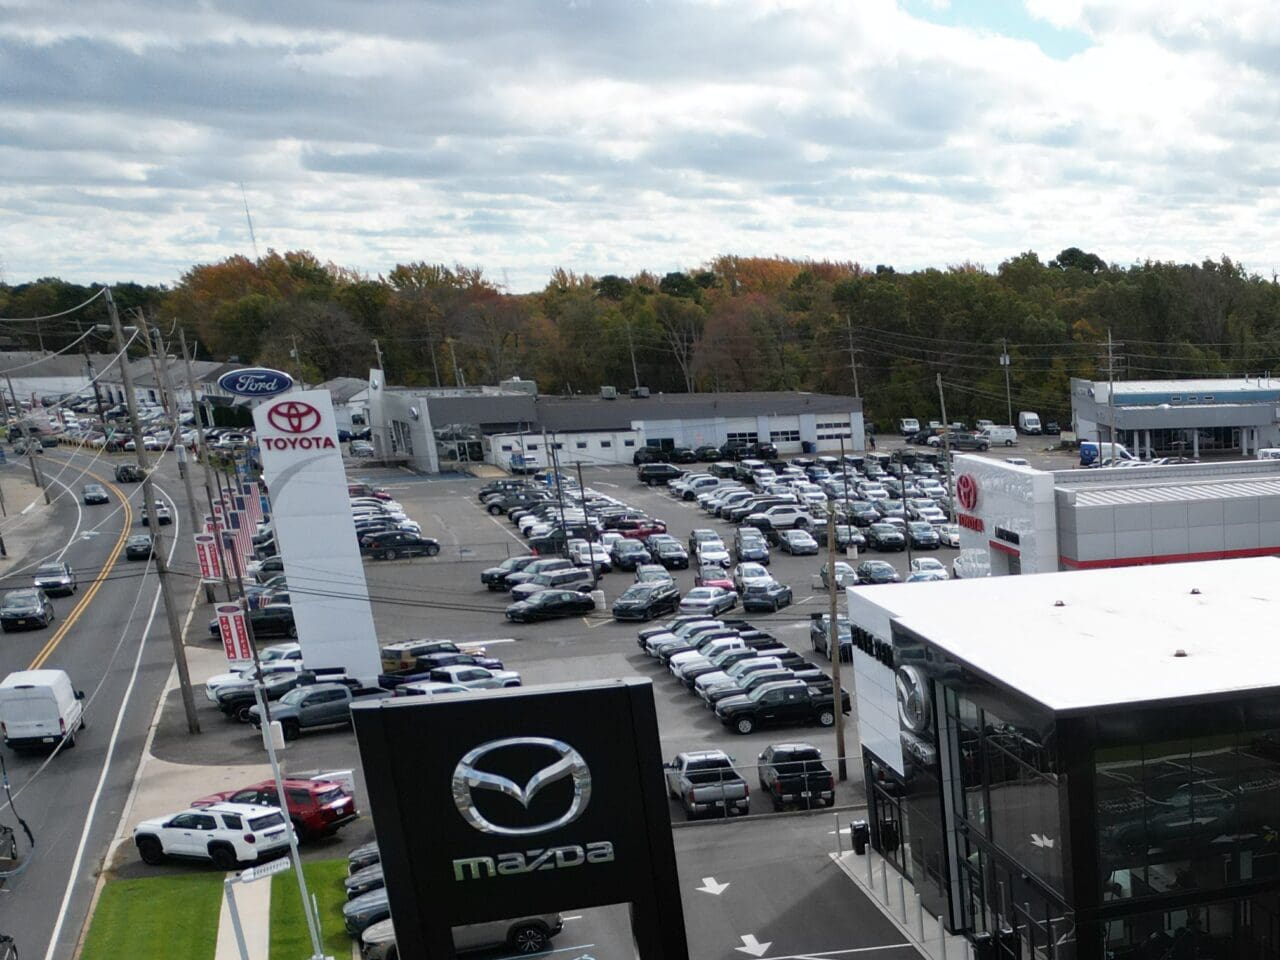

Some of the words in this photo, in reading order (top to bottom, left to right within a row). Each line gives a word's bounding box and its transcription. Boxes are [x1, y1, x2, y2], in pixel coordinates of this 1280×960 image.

[236, 375, 278, 391] Ford
[262, 436, 336, 451] TOYOTA
[220, 616, 236, 659] TOYOTA
[452, 841, 615, 881] mazda
